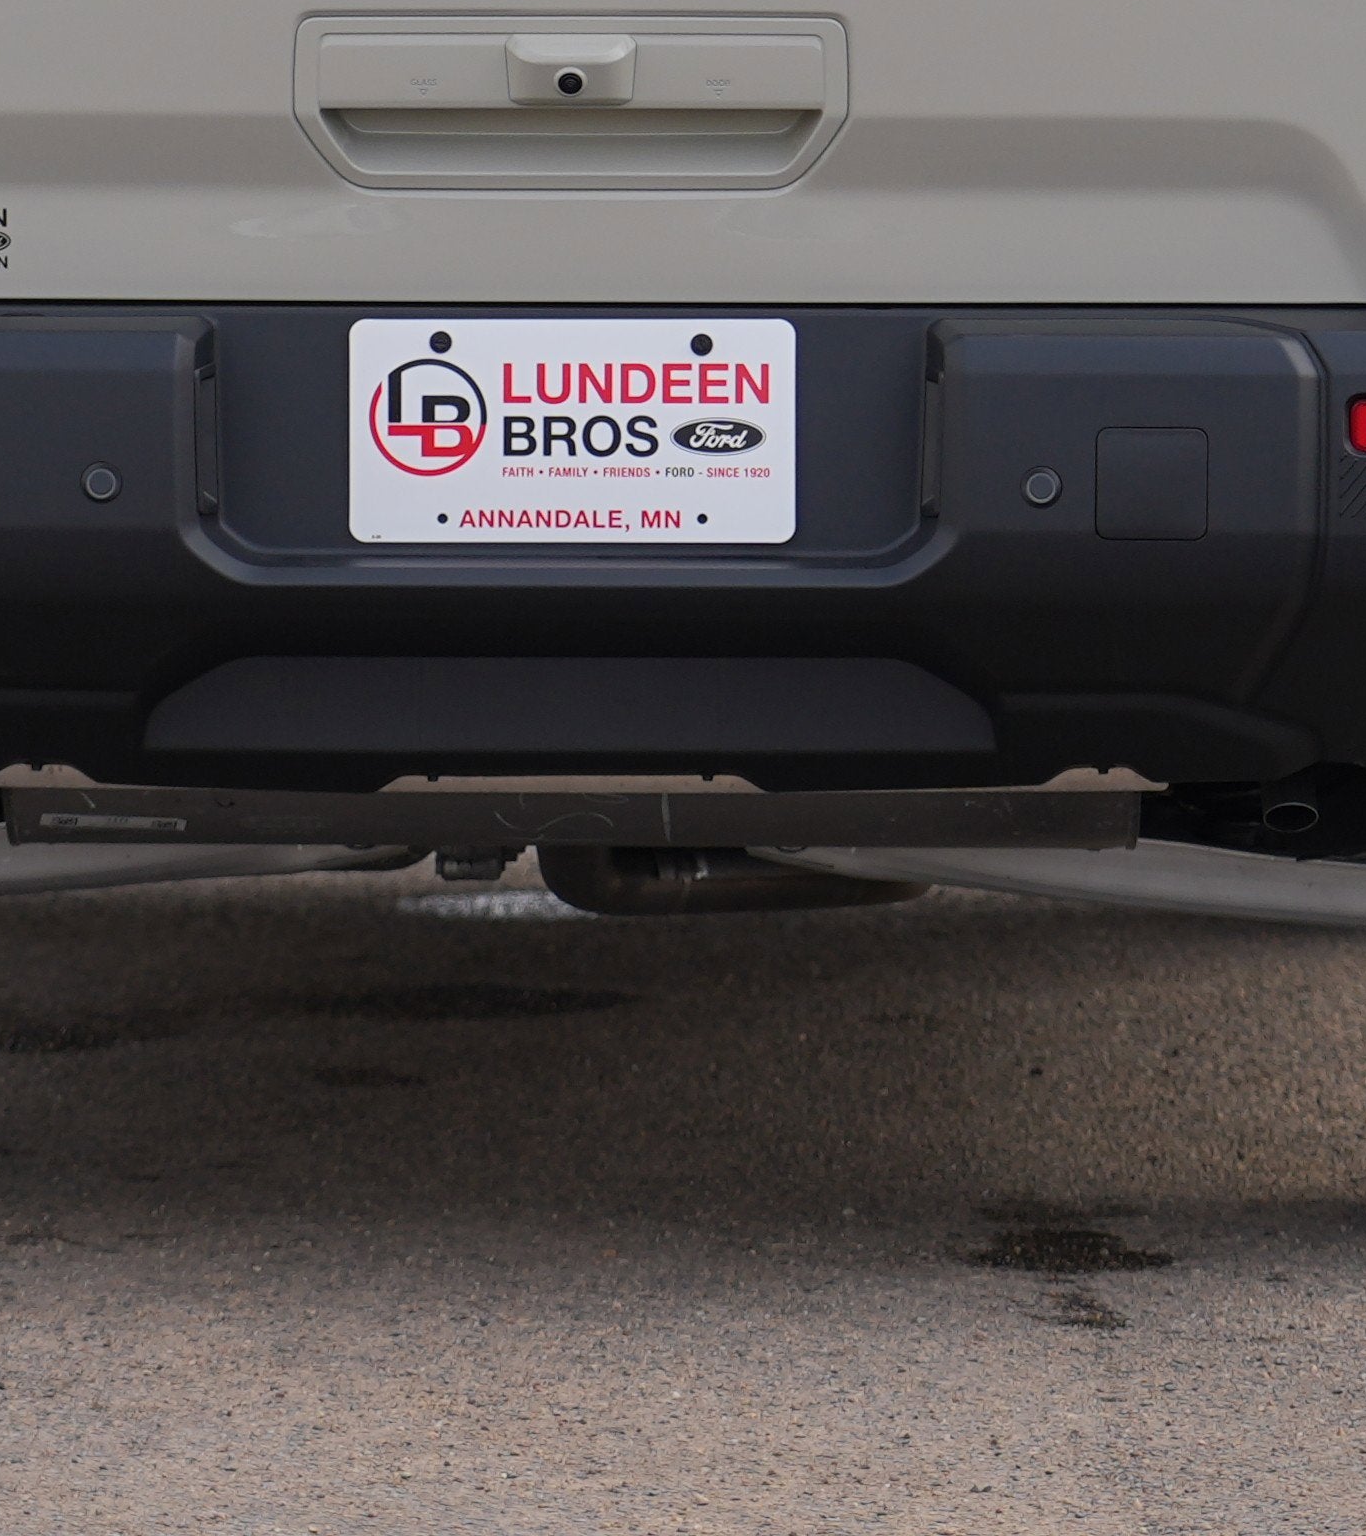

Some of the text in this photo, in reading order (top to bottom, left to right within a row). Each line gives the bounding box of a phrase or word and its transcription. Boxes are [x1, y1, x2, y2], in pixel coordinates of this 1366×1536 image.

[501, 363, 770, 404] LUNDEEN
[502, 414, 748, 458] BROS Ford
[502, 466, 771, 478] FAITH FAMILY FRIENDS FORD SINCE 1920
[459, 509, 682, 531] ANNANDALE, MN
